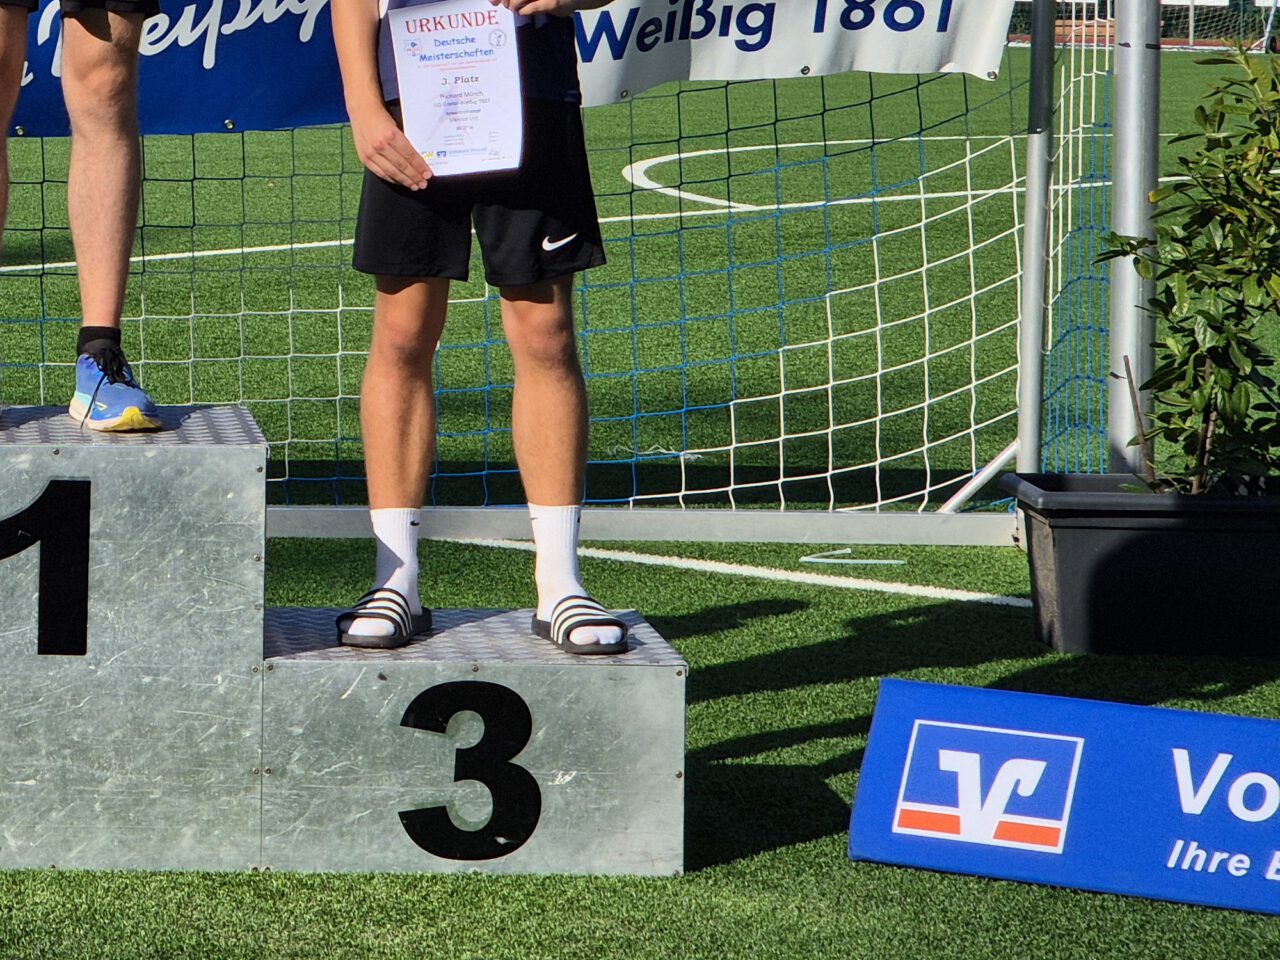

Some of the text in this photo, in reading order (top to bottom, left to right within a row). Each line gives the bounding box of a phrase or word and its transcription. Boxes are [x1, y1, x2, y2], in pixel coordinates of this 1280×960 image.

[405, 9, 499, 34] URKUNDE
[434, 36, 477, 47] Deutsche
[419, 48, 495, 62] Meisterschaften
[441, 76, 480, 86] 3. Platz
[398, 680, 543, 861] 3
[1166, 839, 1251, 877] Ihre
